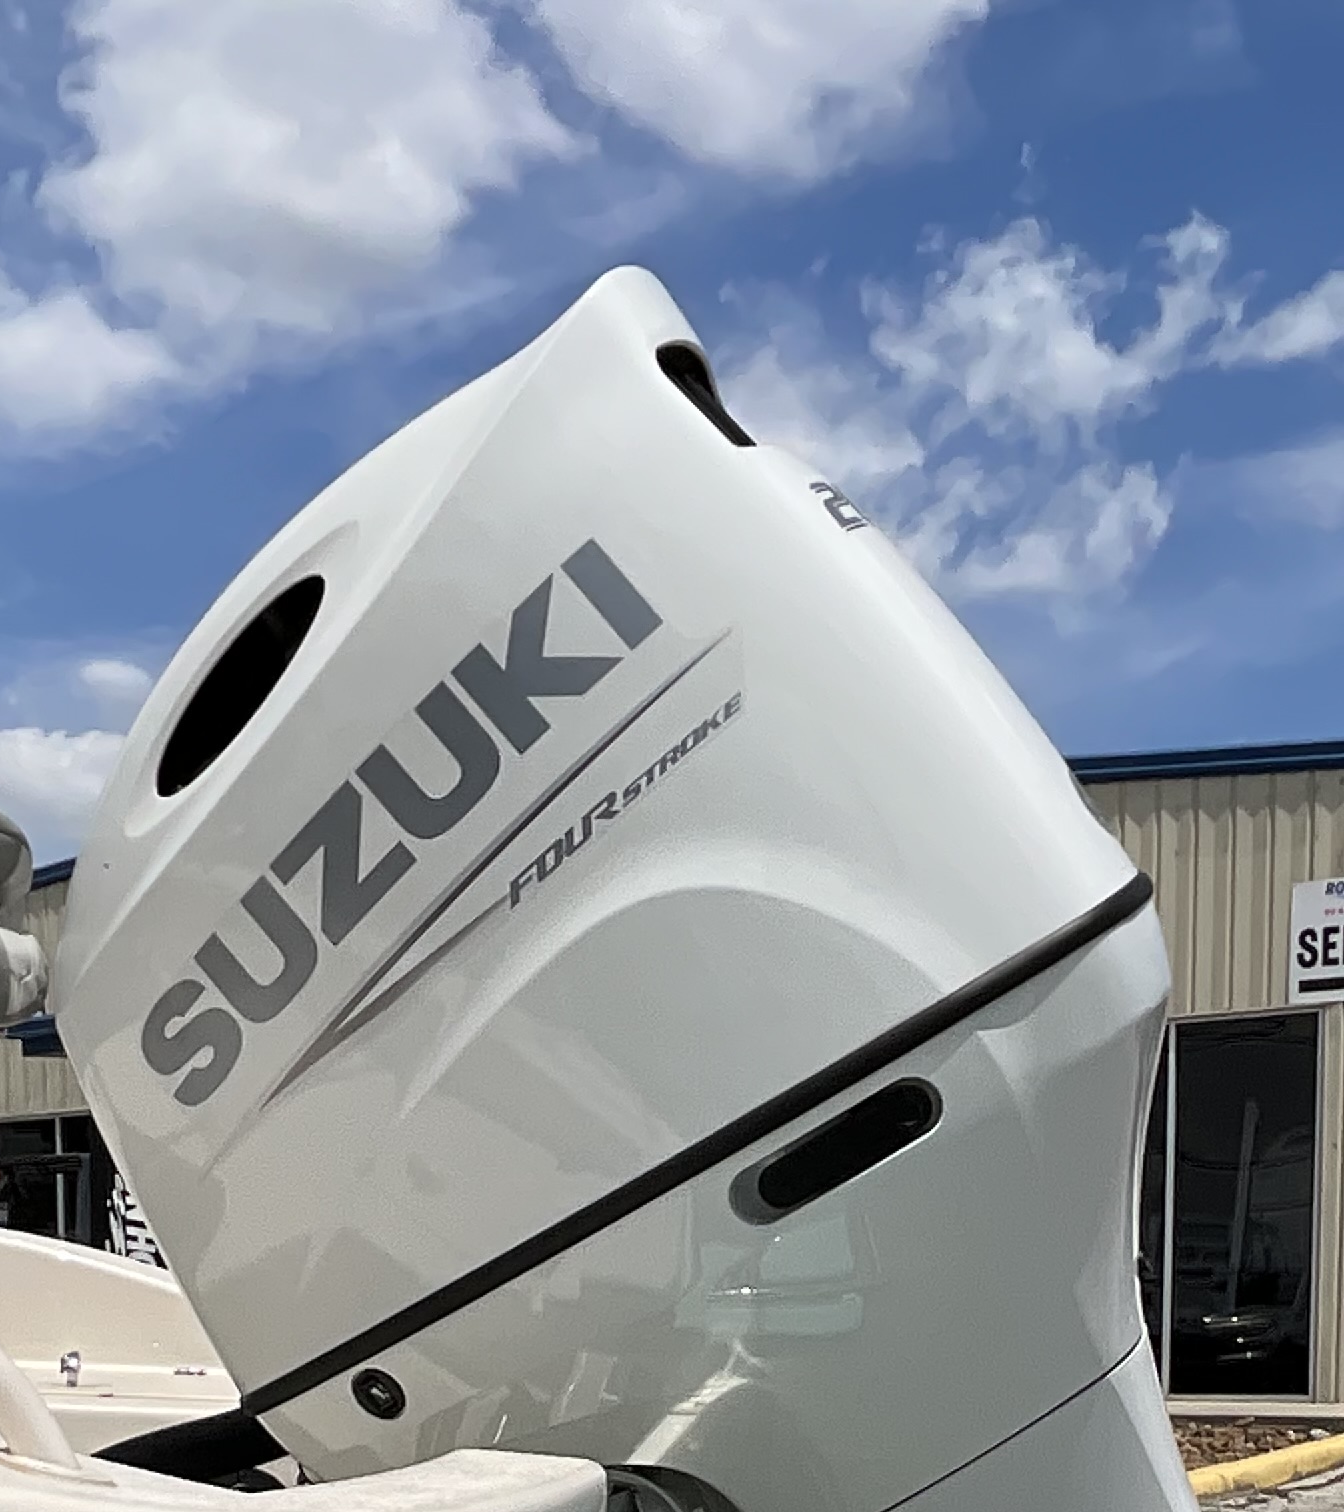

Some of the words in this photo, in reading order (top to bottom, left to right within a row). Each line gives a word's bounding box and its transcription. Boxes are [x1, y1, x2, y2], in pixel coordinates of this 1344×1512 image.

[140, 537, 664, 1107] SUZUKI
[509, 790, 621, 910] FOUR
[621, 690, 742, 808] STROKE
